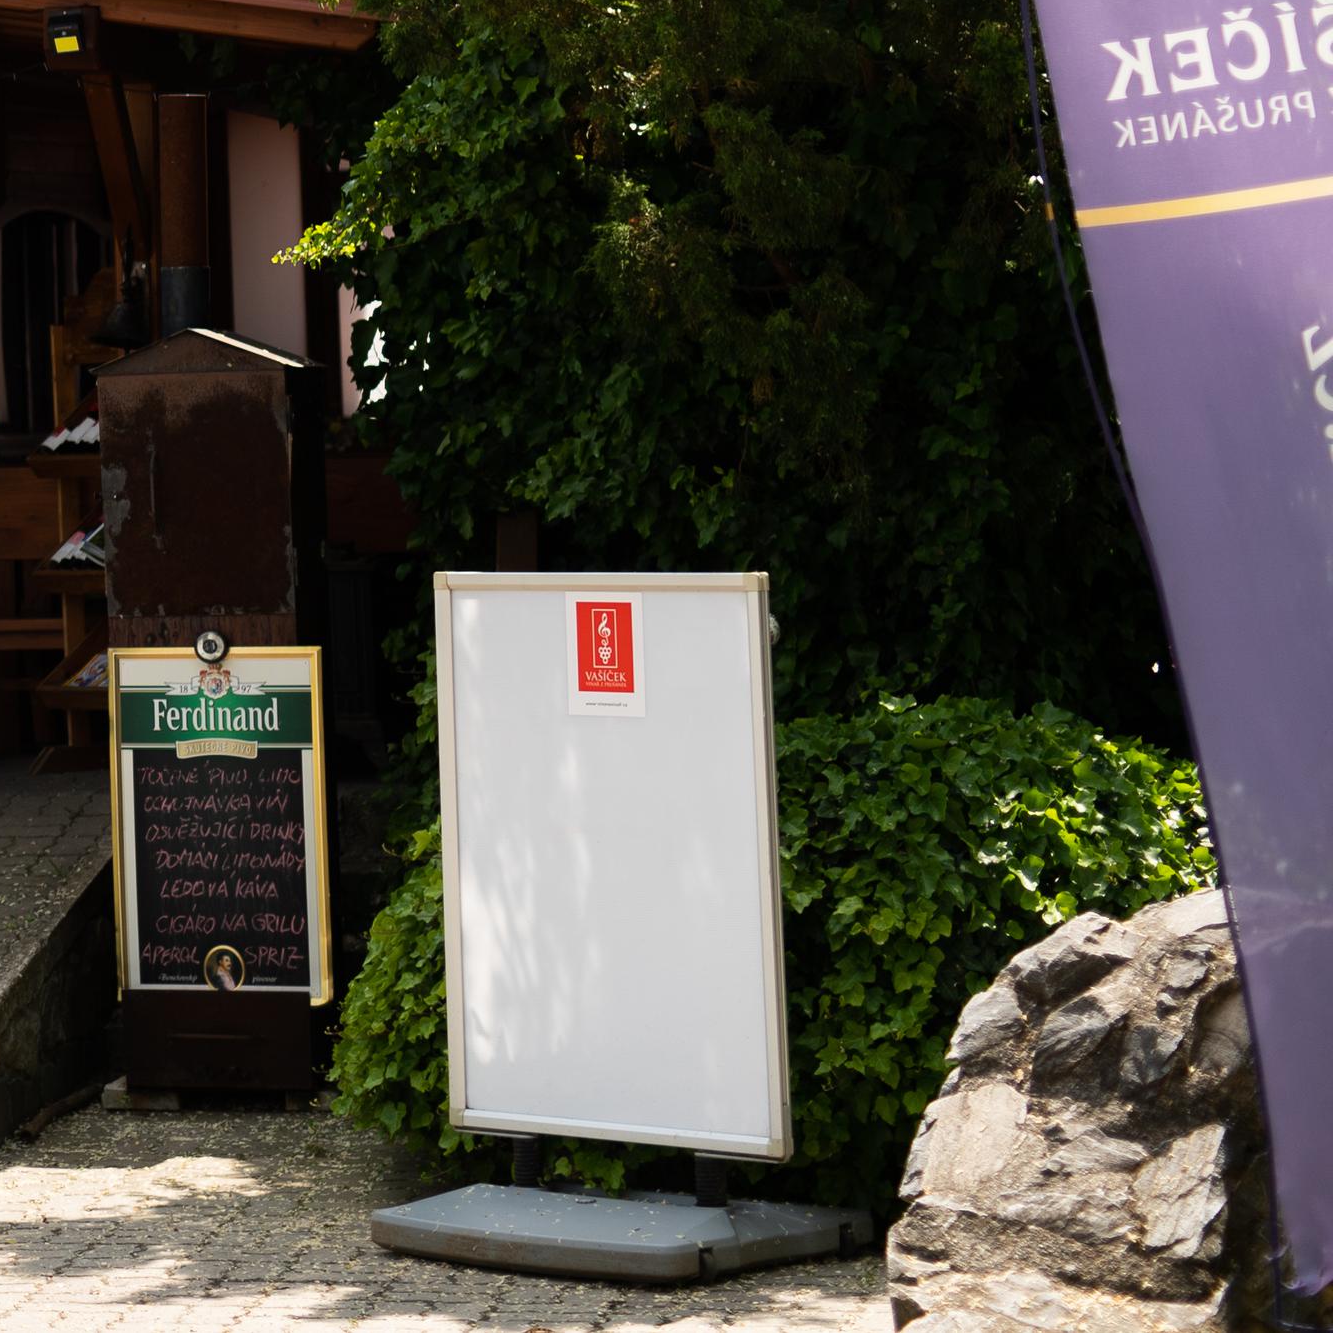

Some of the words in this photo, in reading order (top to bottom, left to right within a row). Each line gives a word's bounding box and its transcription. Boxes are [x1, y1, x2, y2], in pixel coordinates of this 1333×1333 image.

[584, 669, 627, 683] VAŠÍČEK
[179, 685, 189, 694] 18
[240, 685, 252, 694] 97
[152, 697, 280, 732] Ferdinand
[250, 820, 305, 844] DRINKY
[234, 874, 279, 900] KÁVA
[220, 913, 248, 932] NA
[251, 913, 306, 935] GRILU
[140, 942, 200, 966] APEROL
